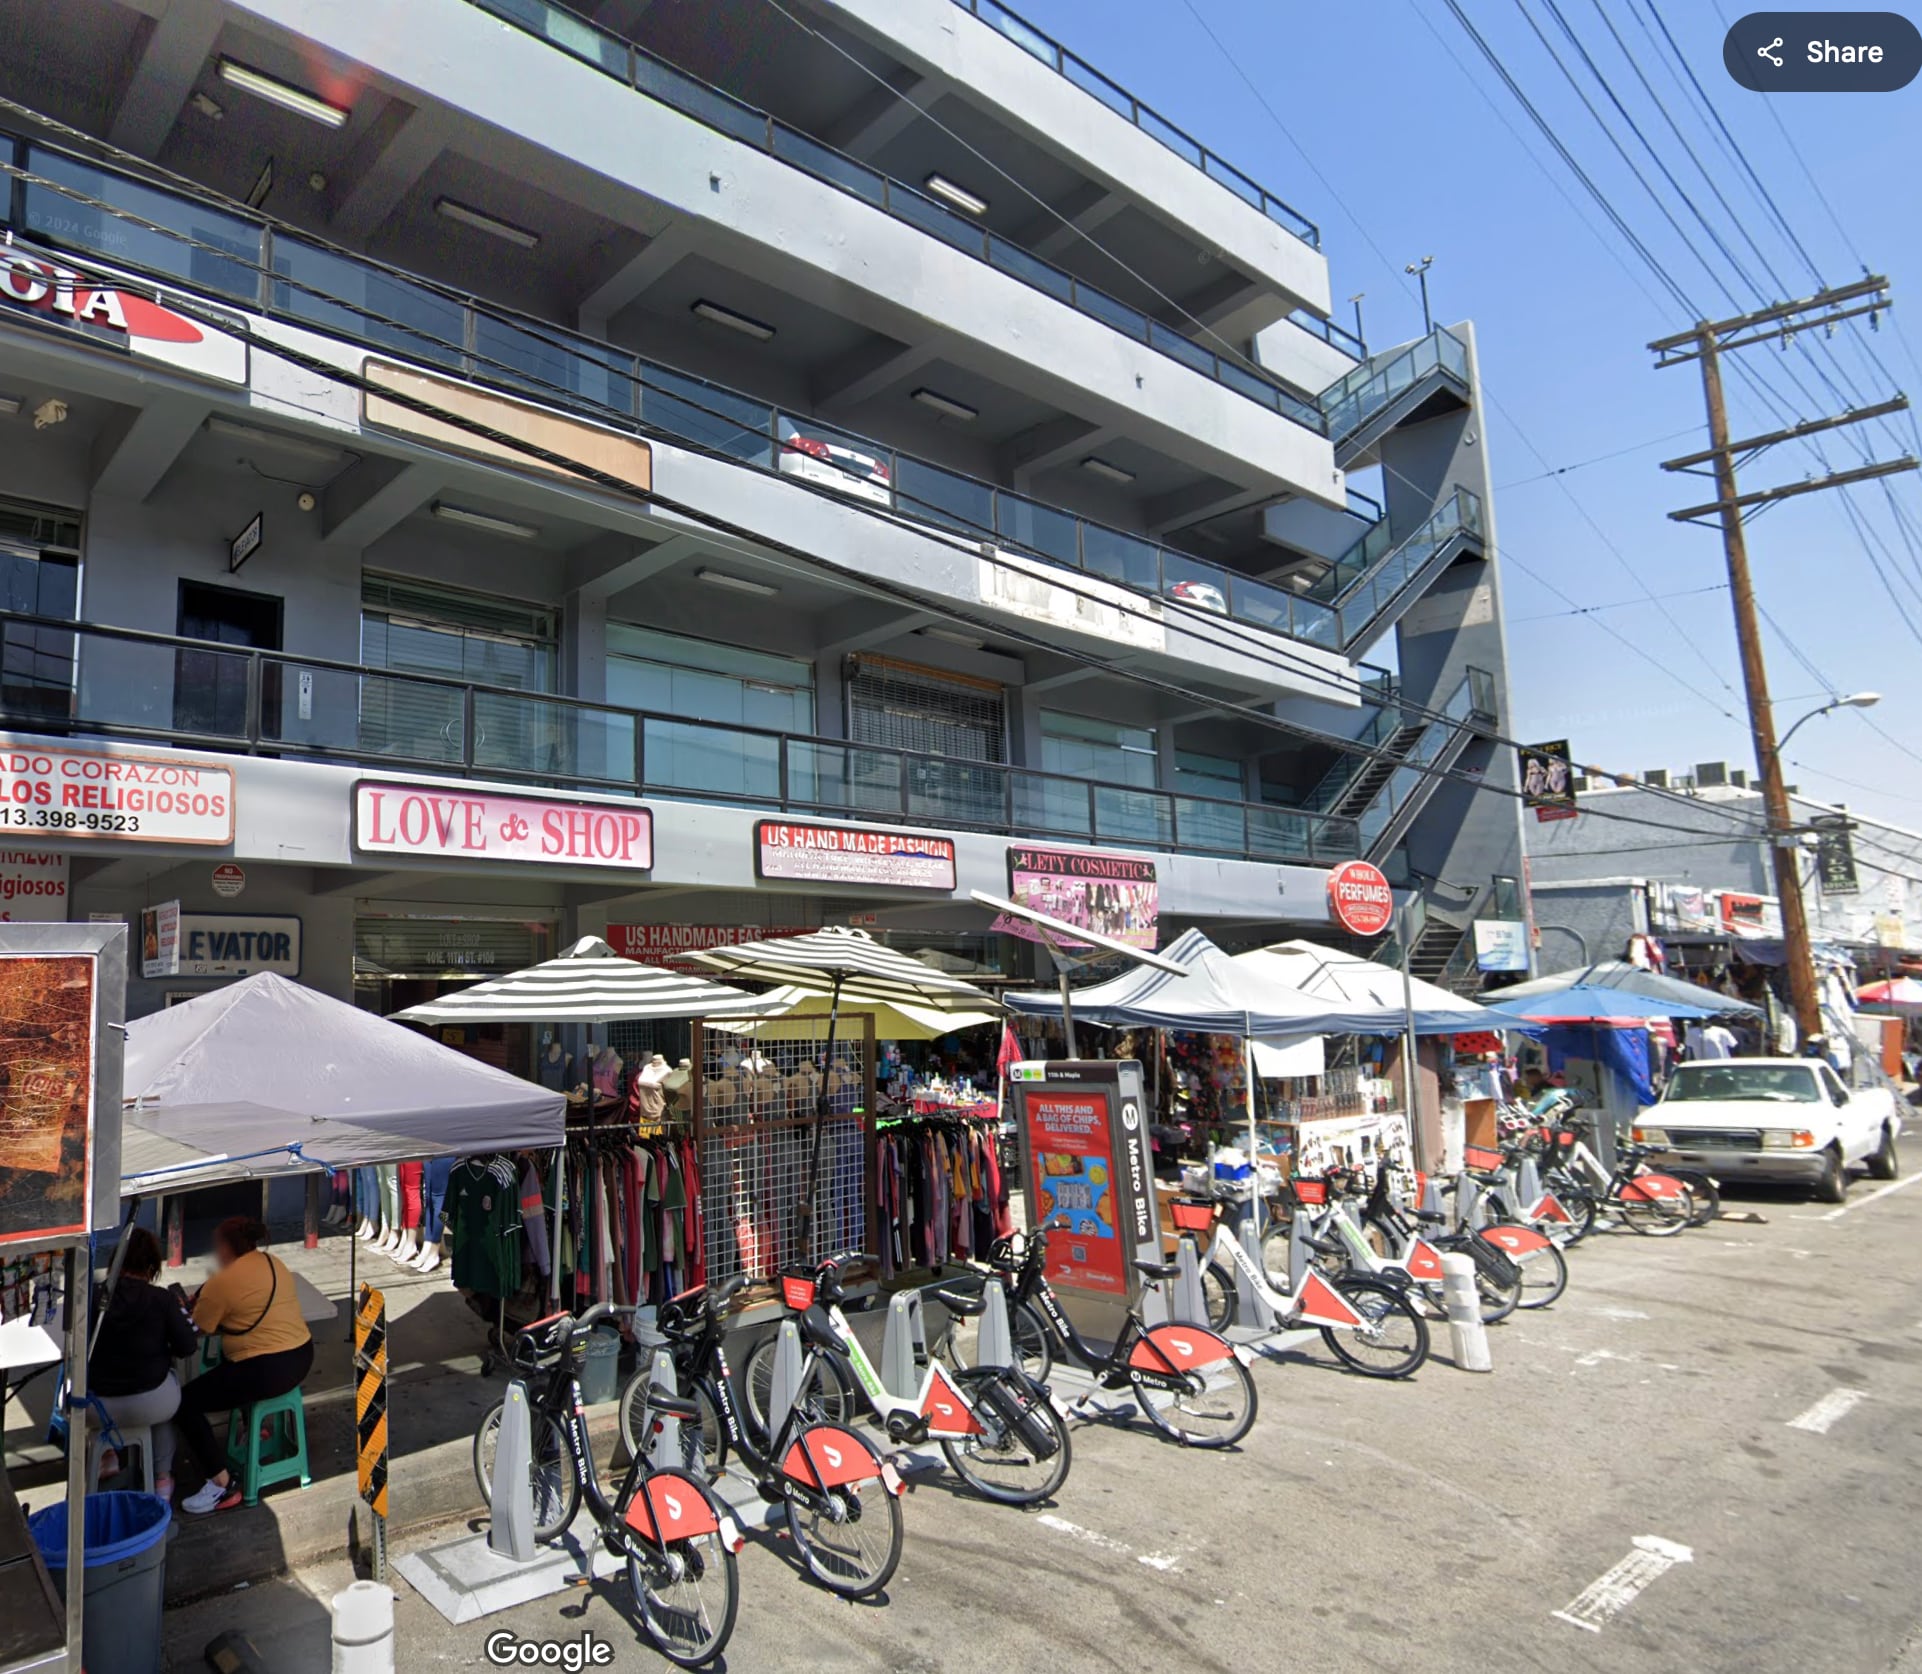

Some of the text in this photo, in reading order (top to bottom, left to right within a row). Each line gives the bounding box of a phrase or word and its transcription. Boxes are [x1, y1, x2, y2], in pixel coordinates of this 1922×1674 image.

[61, 759, 199, 787] CORAZON
[62, 784, 225, 817] RELIGIOSOS
[0, 808, 140, 832] 13.398-9523
[368, 792, 641, 860] LOVE & SHOP
[768, 826, 949, 858] US HAND MADE FASHION
[1027, 853, 1144, 879] LETY COSMETIC
[0, 874, 65, 900] igiosos
[1340, 882, 1388, 903] PERFUMES
[180, 931, 290, 961] EVATOR
[625, 926, 646, 946] US
[650, 927, 735, 947] HANDMADE
[1036, 1113, 1101, 1126] A BAG OF CHIPS,
[1040, 1104, 1093, 1114] ALL THIS AND
[1045, 1123, 1093, 1134] DELIVERED.
[1128, 1139, 1141, 1192] Metro
[1135, 1198, 1148, 1236] Bike
[1235, 1251, 1251, 1275] Metro
[1040, 1291, 1070, 1338] Metro Bike
[1143, 1375, 1167, 1388] Metro
[717, 1380, 731, 1414] Metro
[727, 1416, 739, 1442] Bike
[570, 1418, 582, 1455] Metro
[578, 1458, 587, 1485] Bike
[793, 1488, 810, 1505] Metro
